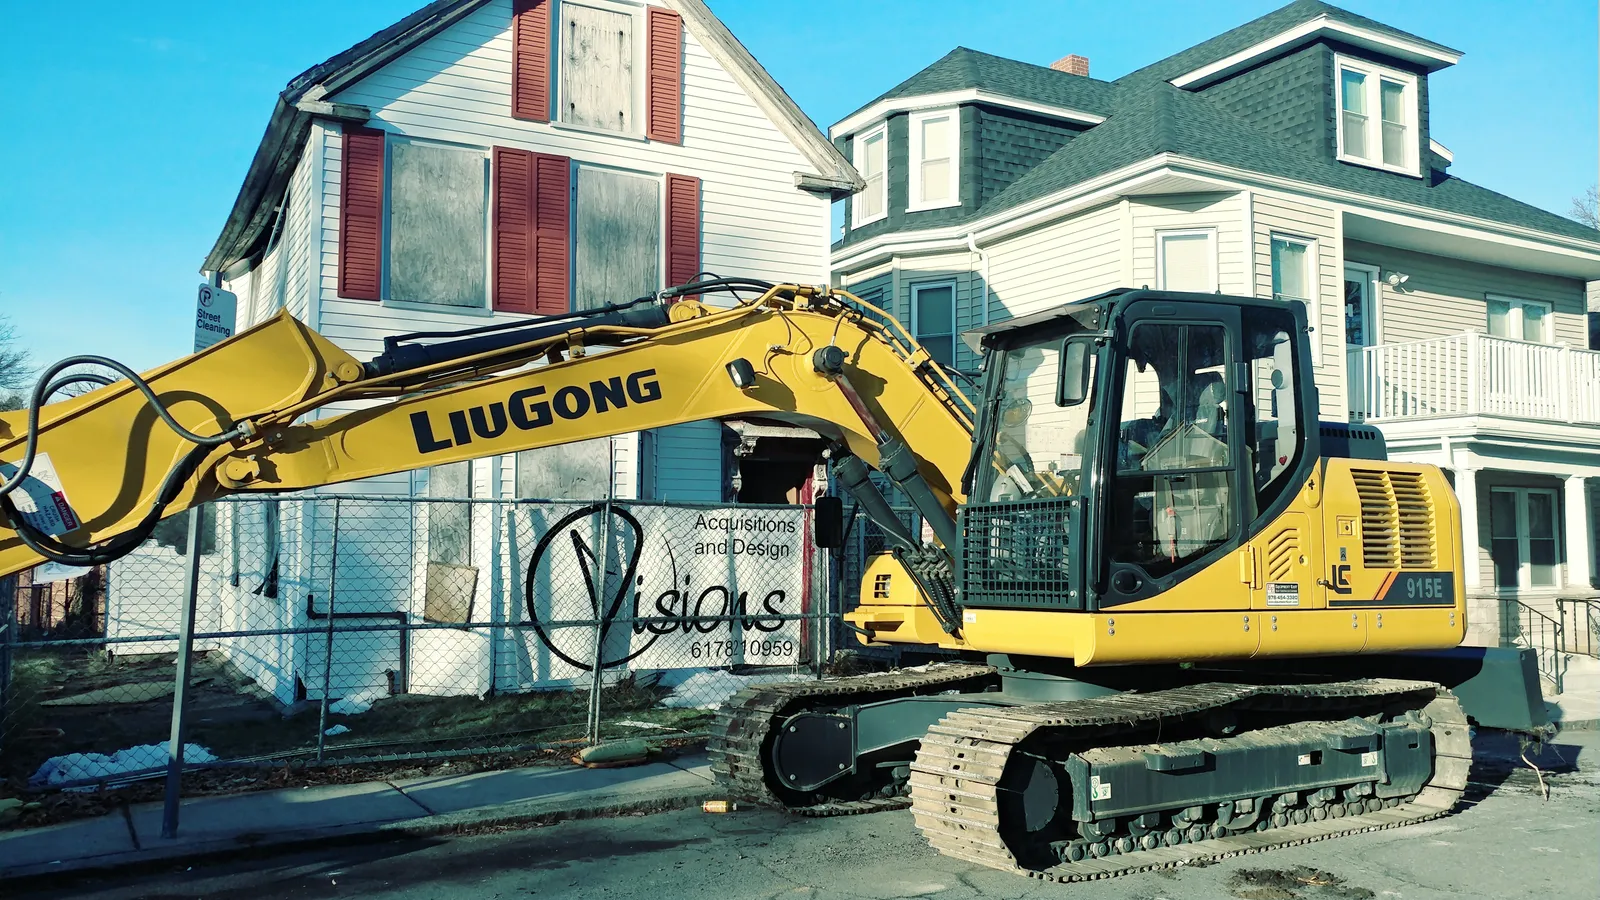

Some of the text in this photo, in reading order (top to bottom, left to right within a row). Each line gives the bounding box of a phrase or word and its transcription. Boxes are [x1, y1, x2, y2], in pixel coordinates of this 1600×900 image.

[197, 309, 221, 323] Street
[196, 319, 231, 338] Cleaning
[58, 502, 73, 527] DANGER
[695, 513, 796, 534] Acquisitions
[695, 537, 790, 560] and Design
[526, 502, 786, 671] Visions
[1406, 577, 1443, 599] 915E
